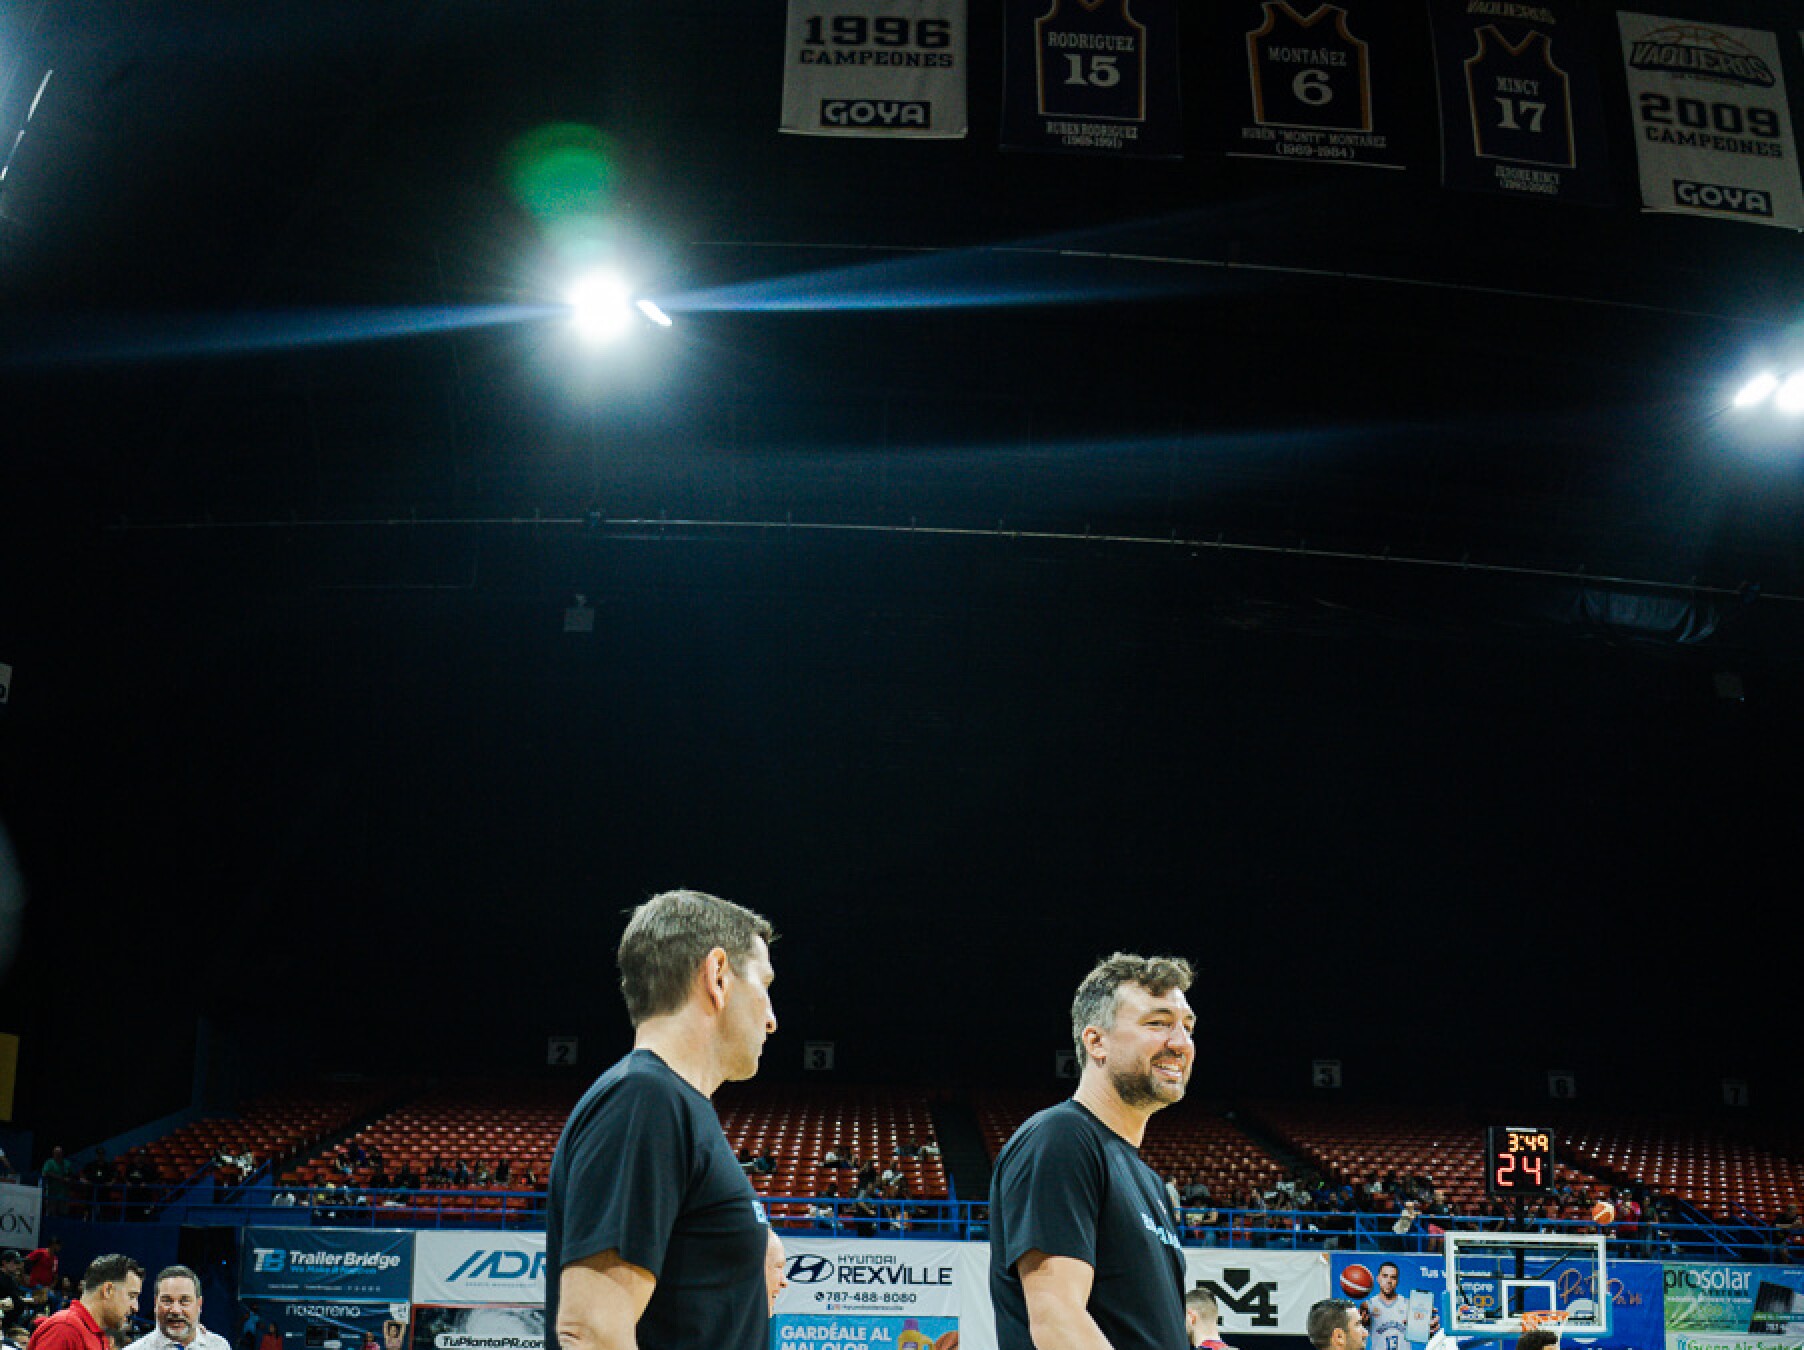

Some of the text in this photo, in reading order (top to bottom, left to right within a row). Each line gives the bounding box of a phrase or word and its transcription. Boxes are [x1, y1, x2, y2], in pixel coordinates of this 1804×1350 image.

[804, 16, 951, 48] 1996
[1047, 31, 1135, 51] RODRIGUEZ
[800, 50, 953, 69] CAMPEONES
[1267, 46, 1347, 67] MONTAÑEZ
[1630, 42, 1774, 87] VAQUEROS
[1063, 53, 1120, 87] 15
[1292, 68, 1334, 105] 6
[824, 101, 926, 125] GOYA
[1494, 97, 1547, 133] 17
[1639, 93, 1780, 138] 2009
[1645, 126, 1783, 158] CAMPEONES
[1677, 183, 1767, 212] GOYA
[557, 1045, 569, 1063] 2
[812, 1049, 827, 1067] 3
[1319, 1067, 1333, 1086] 5
[1508, 1133, 1549, 1152] 3:49
[1497, 1153, 1541, 1187] 24
[253, 1248, 286, 1272] TB
[290, 1251, 343, 1266] Trailer
[344, 1251, 400, 1271] Bridge
[838, 1254, 897, 1265] HYUNDAI
[837, 1264, 953, 1285] REXVILLE
[1664, 1267, 1753, 1294] prosolar
[781, 1322, 892, 1341] GARDÉALE AL
